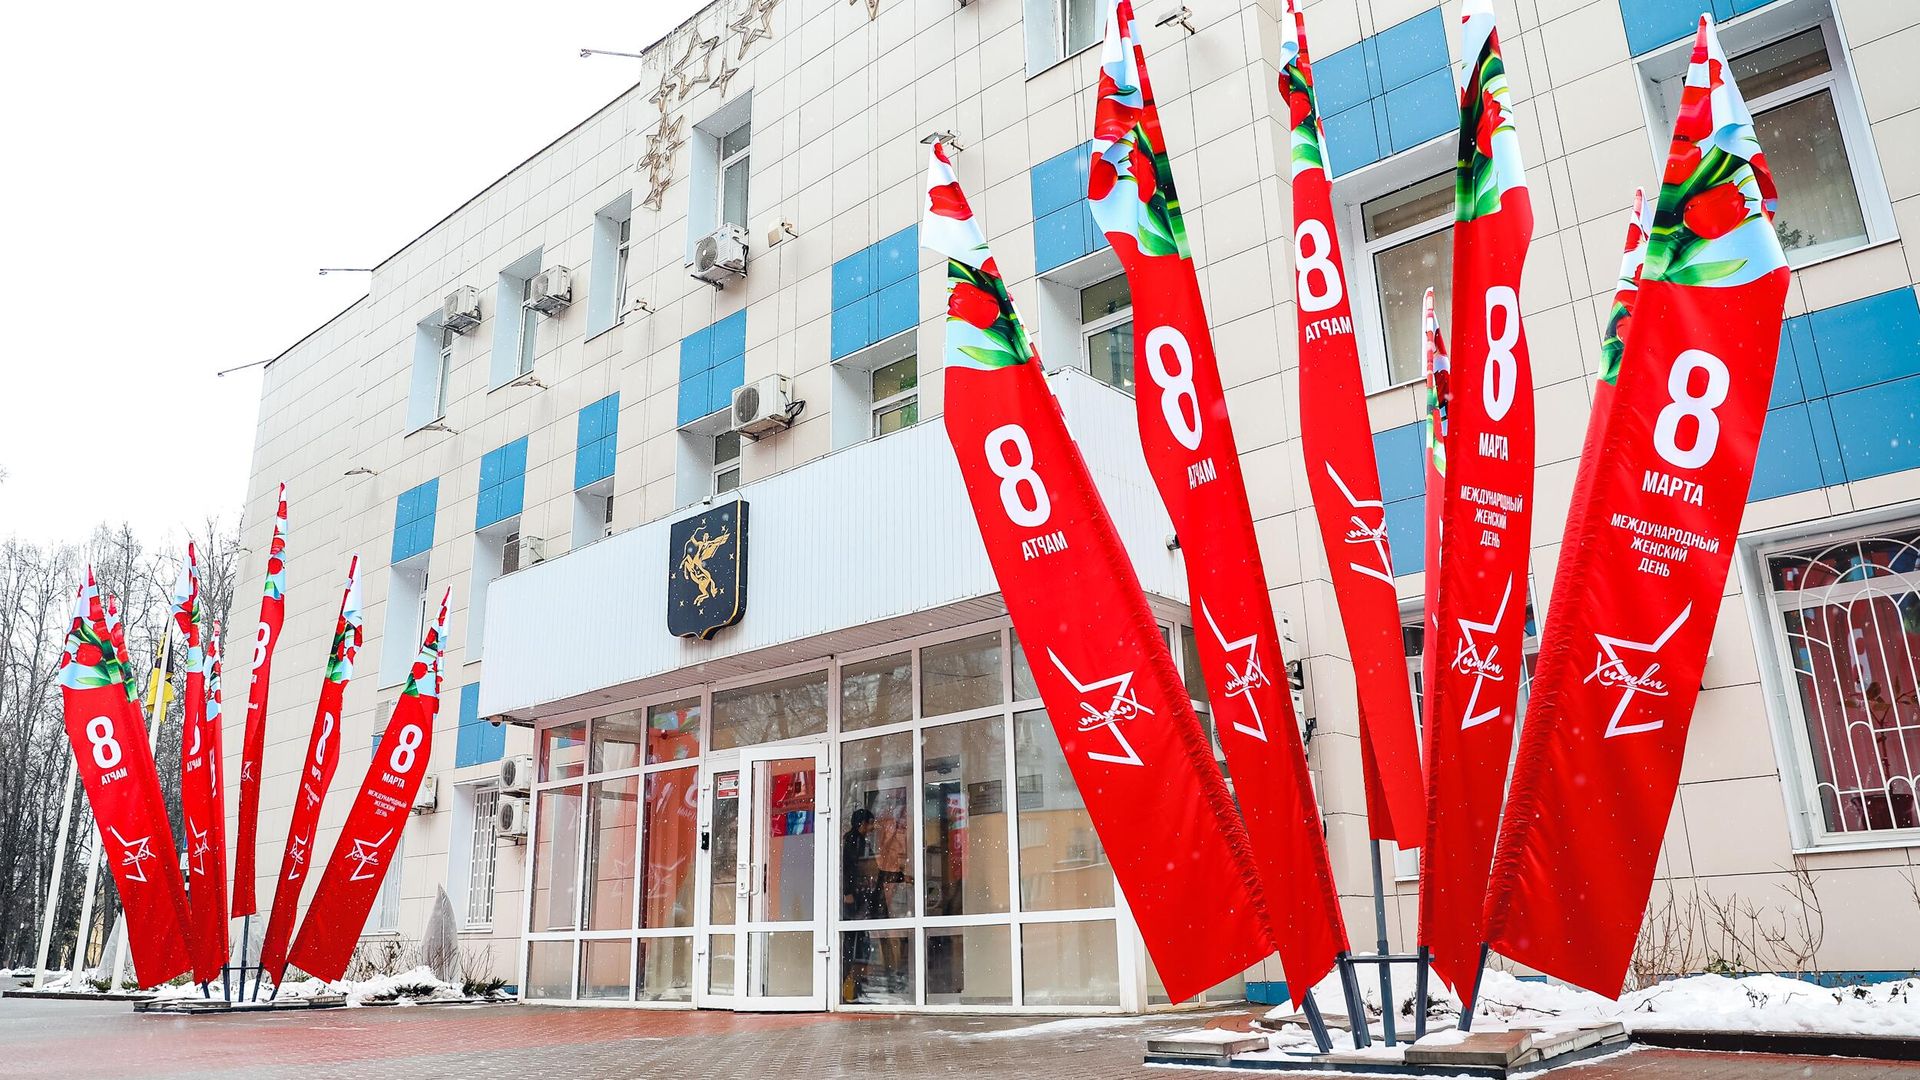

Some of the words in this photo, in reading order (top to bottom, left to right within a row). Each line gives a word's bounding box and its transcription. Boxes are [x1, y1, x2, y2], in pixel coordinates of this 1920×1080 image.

[1482, 285, 1520, 422] 8
[1653, 348, 1730, 469] 8
[1478, 432, 1509, 461] МАРТА
[1460, 485, 1523, 513] МЕЖДУНАРОДНЫЙ
[1641, 470, 1704, 507] МАРТА
[1474, 507, 1507, 530] ЖЕНСКИЙ
[1480, 530, 1501, 548] ДЕНЬ
[1610, 512, 1720, 554] МЕЖДУНАРОДНЫЙ
[1630, 535, 1688, 562] ЖЕНСКИЙ
[1637, 557, 1670, 577] ДЕНЬ
[389, 723, 423, 774] 8
[382, 772, 405, 789] МАРТА
